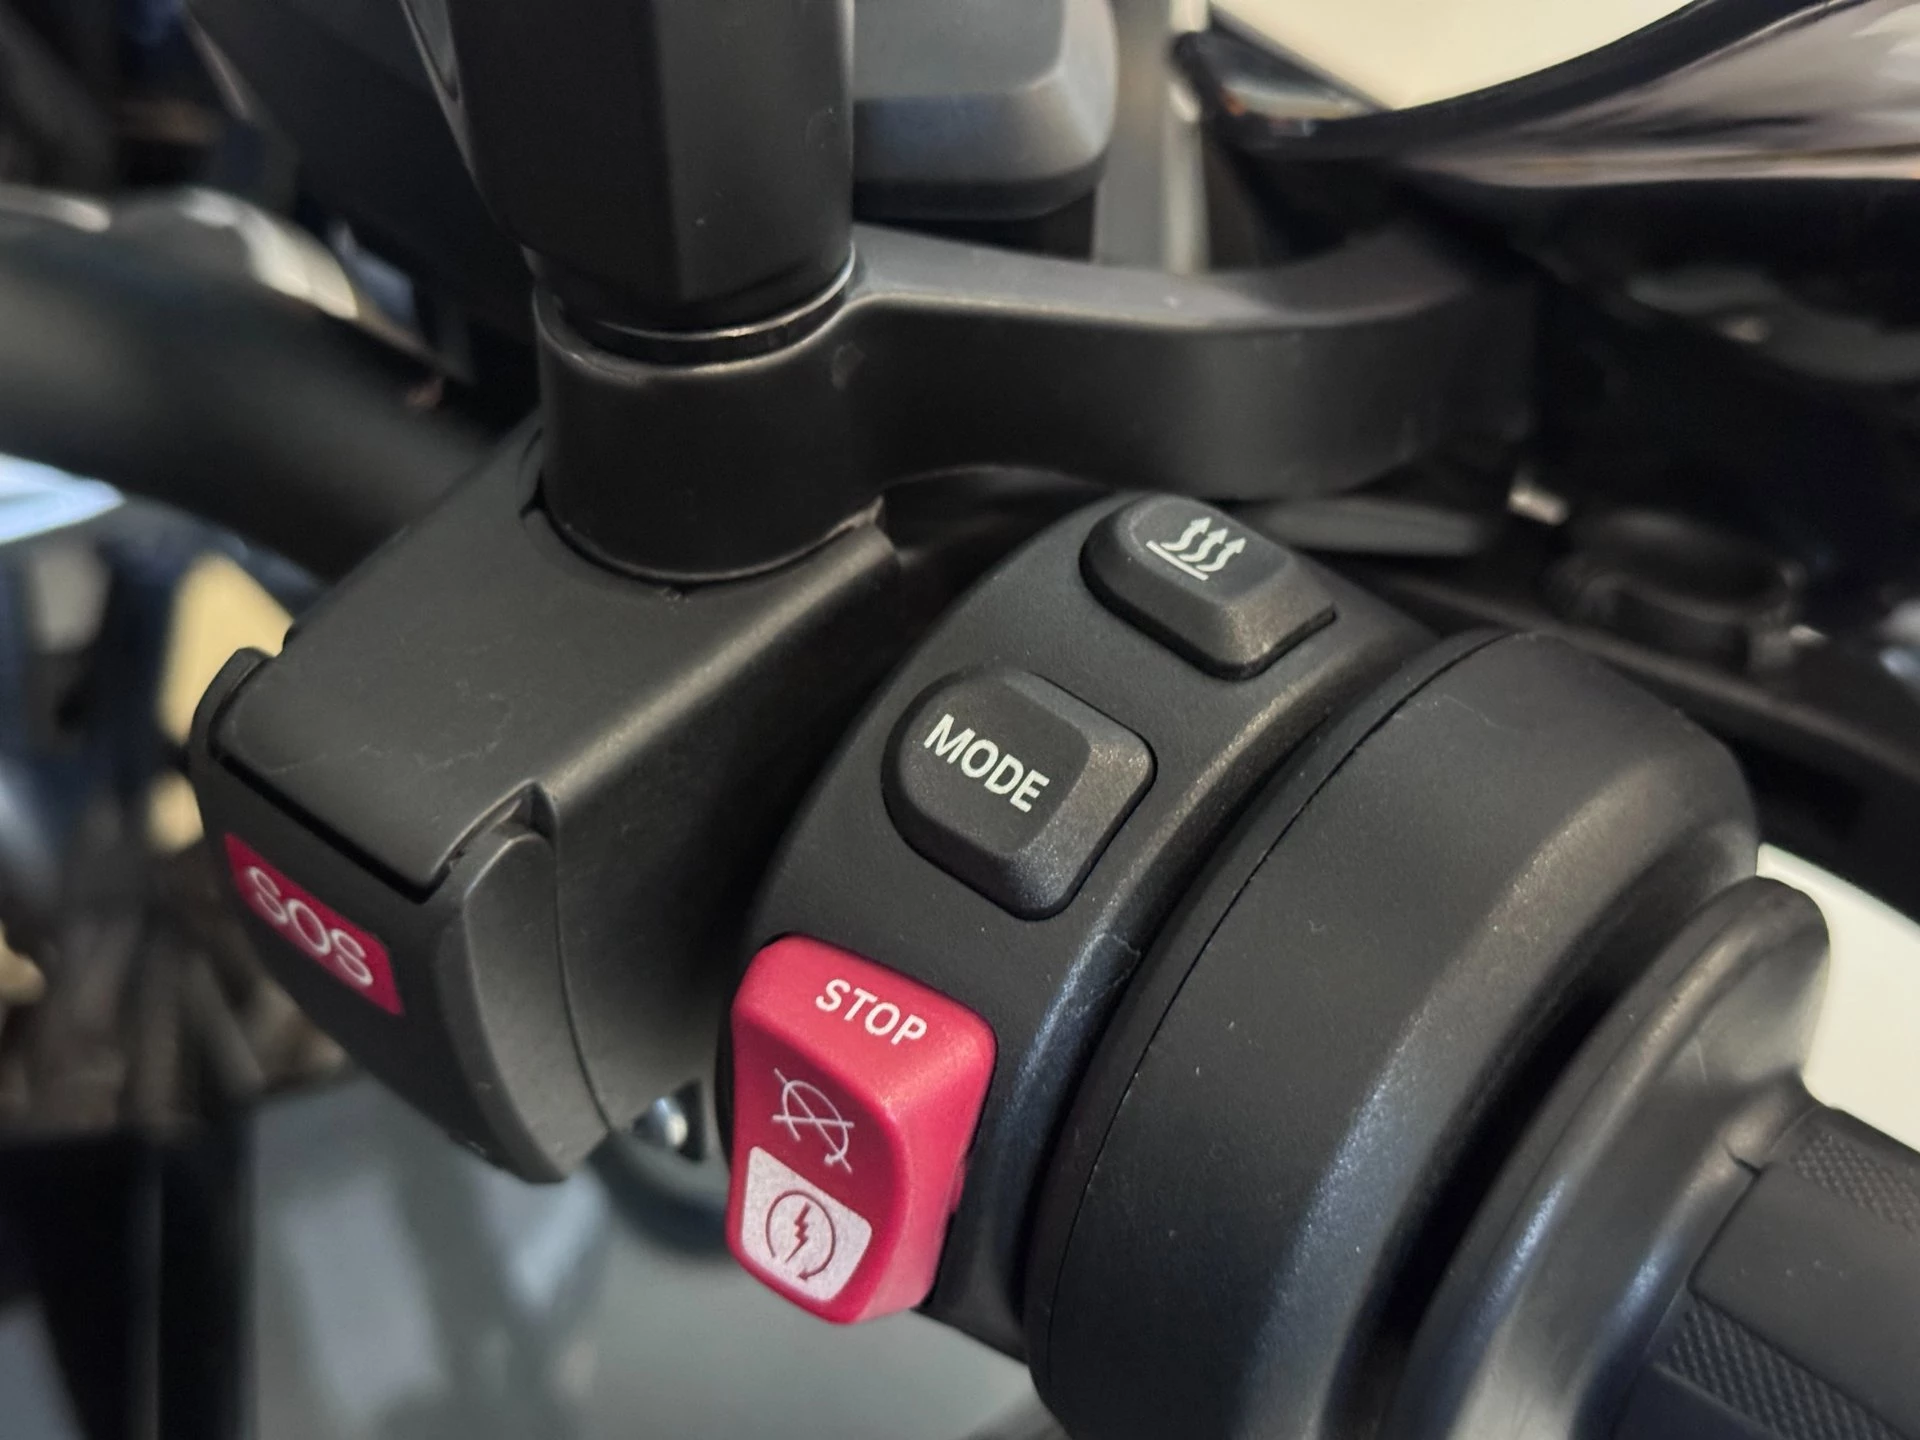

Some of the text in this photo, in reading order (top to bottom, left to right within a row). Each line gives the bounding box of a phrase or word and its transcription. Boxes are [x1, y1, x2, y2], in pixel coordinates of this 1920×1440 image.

[923, 713, 1051, 813] MODE
[247, 866, 374, 986] SOS
[815, 978, 928, 1046] STOP
